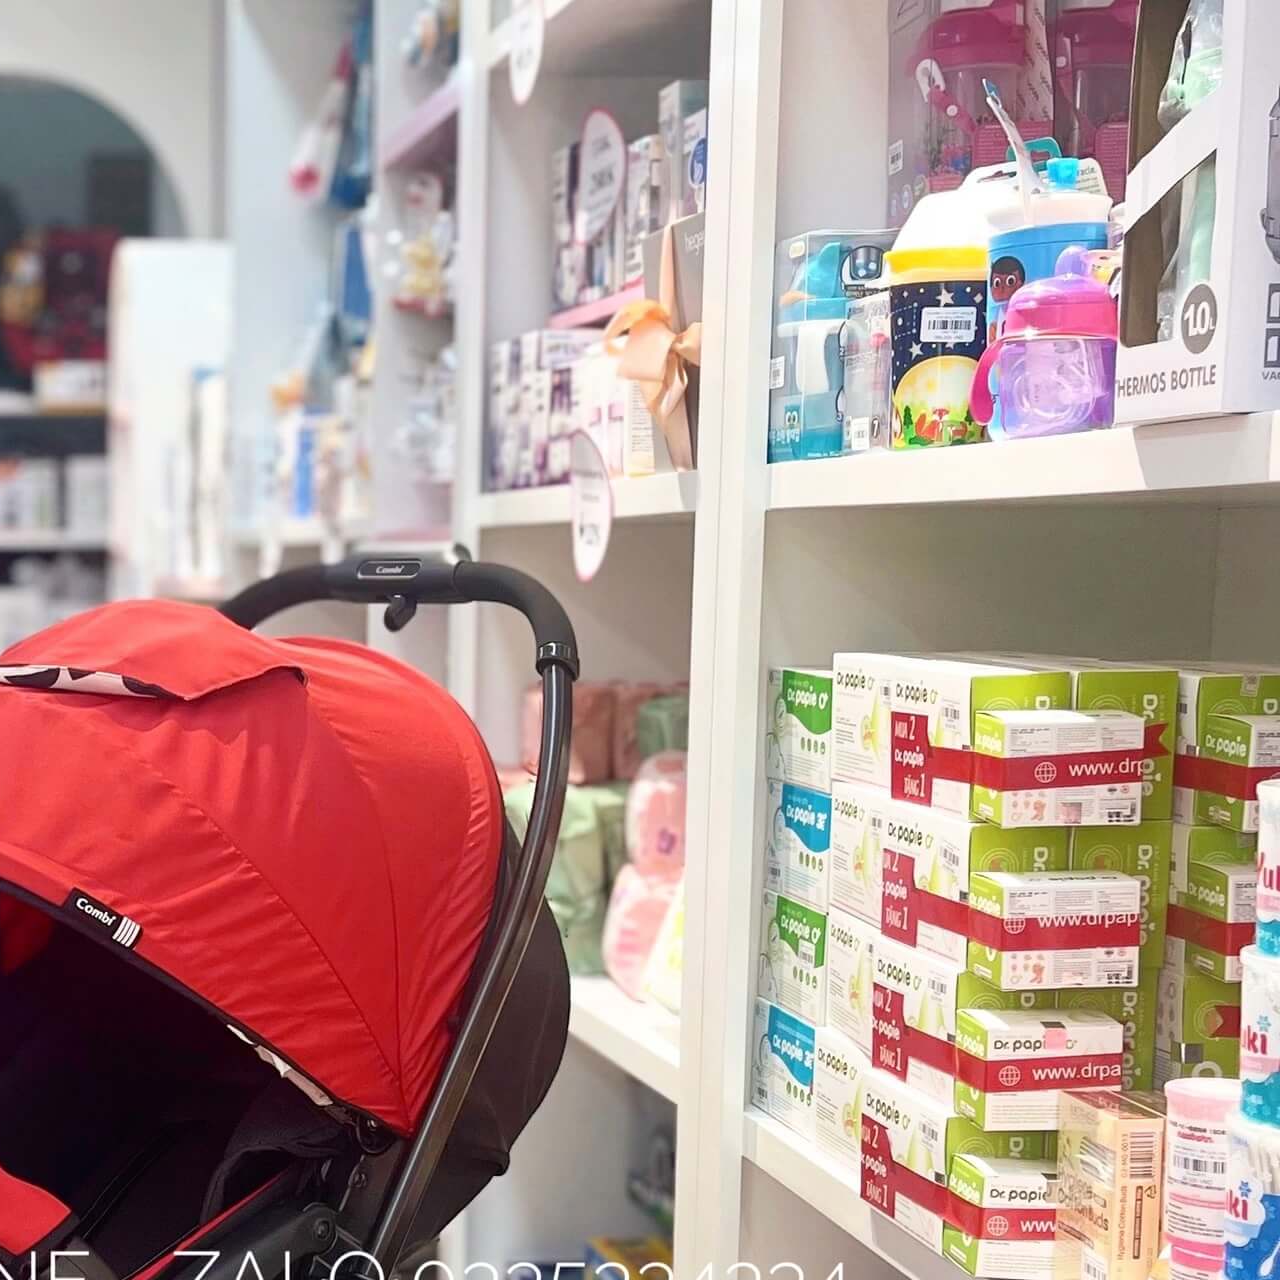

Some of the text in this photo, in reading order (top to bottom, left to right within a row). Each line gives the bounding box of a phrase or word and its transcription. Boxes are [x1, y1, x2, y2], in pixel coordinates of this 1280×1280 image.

[1116, 364, 1217, 399] HERMOS BOTTLE
[908, 715, 915, 741] 2
[76, 897, 117, 926] Combi
[885, 990, 892, 1013] 2
[994, 1035, 1047, 1052] Dr. papi
[1032, 1063, 1121, 1081] www.drpa
[872, 1125, 878, 1148] 2
[990, 1189, 1006, 1199] Dr.
